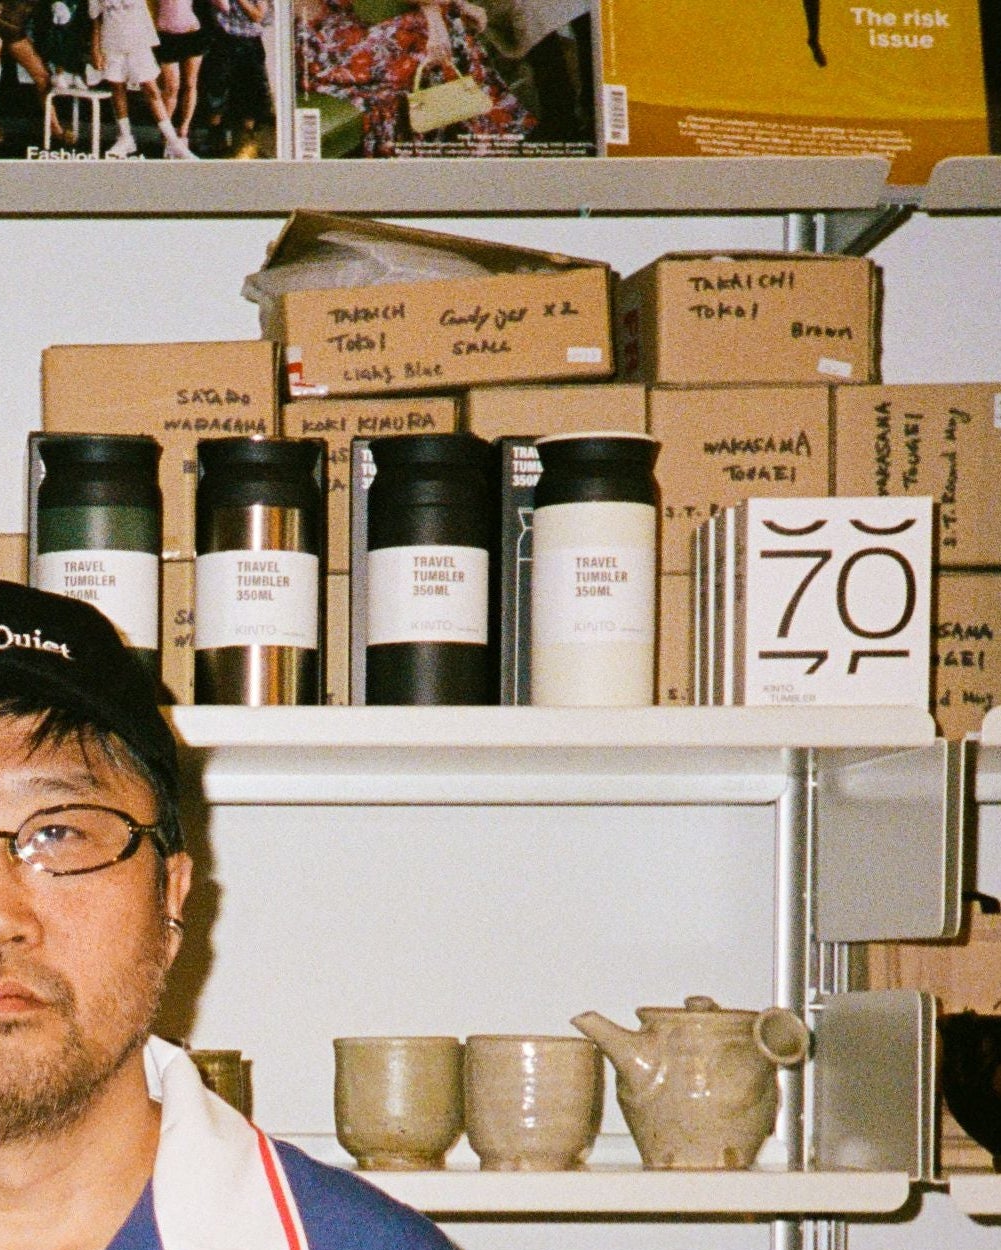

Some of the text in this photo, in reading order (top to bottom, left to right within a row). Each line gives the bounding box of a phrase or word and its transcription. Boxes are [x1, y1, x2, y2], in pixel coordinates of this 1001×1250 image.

[850, 7, 950, 28] The risk
[869, 29, 934, 48] issue
[688, 271, 795, 292] TAKAICHI
[688, 302, 758, 320] TOKOI
[791, 321, 853, 340] Brown
[452, 340, 511, 355] SMALL
[404, 361, 443, 378] Blue
[358, 412, 436, 433] KIMURA
[704, 430, 811, 457] WAKASAMA
[64, 561, 106, 572] TRAVEL
[237, 562, 279, 573] TRAVEL
[413, 557, 455, 568] TRAVEL
[576, 557, 618, 568] TRAVEL
[64, 575, 116, 586] TUMBLER
[237, 576, 289, 587] TUMBLER
[413, 571, 465, 582] TUMBLER
[576, 571, 628, 582] TUMBLER
[236, 590, 274, 601] 350ML
[412, 585, 450, 596] 350ML
[575, 585, 613, 596] 350ML
[758, 547, 917, 640] 70
